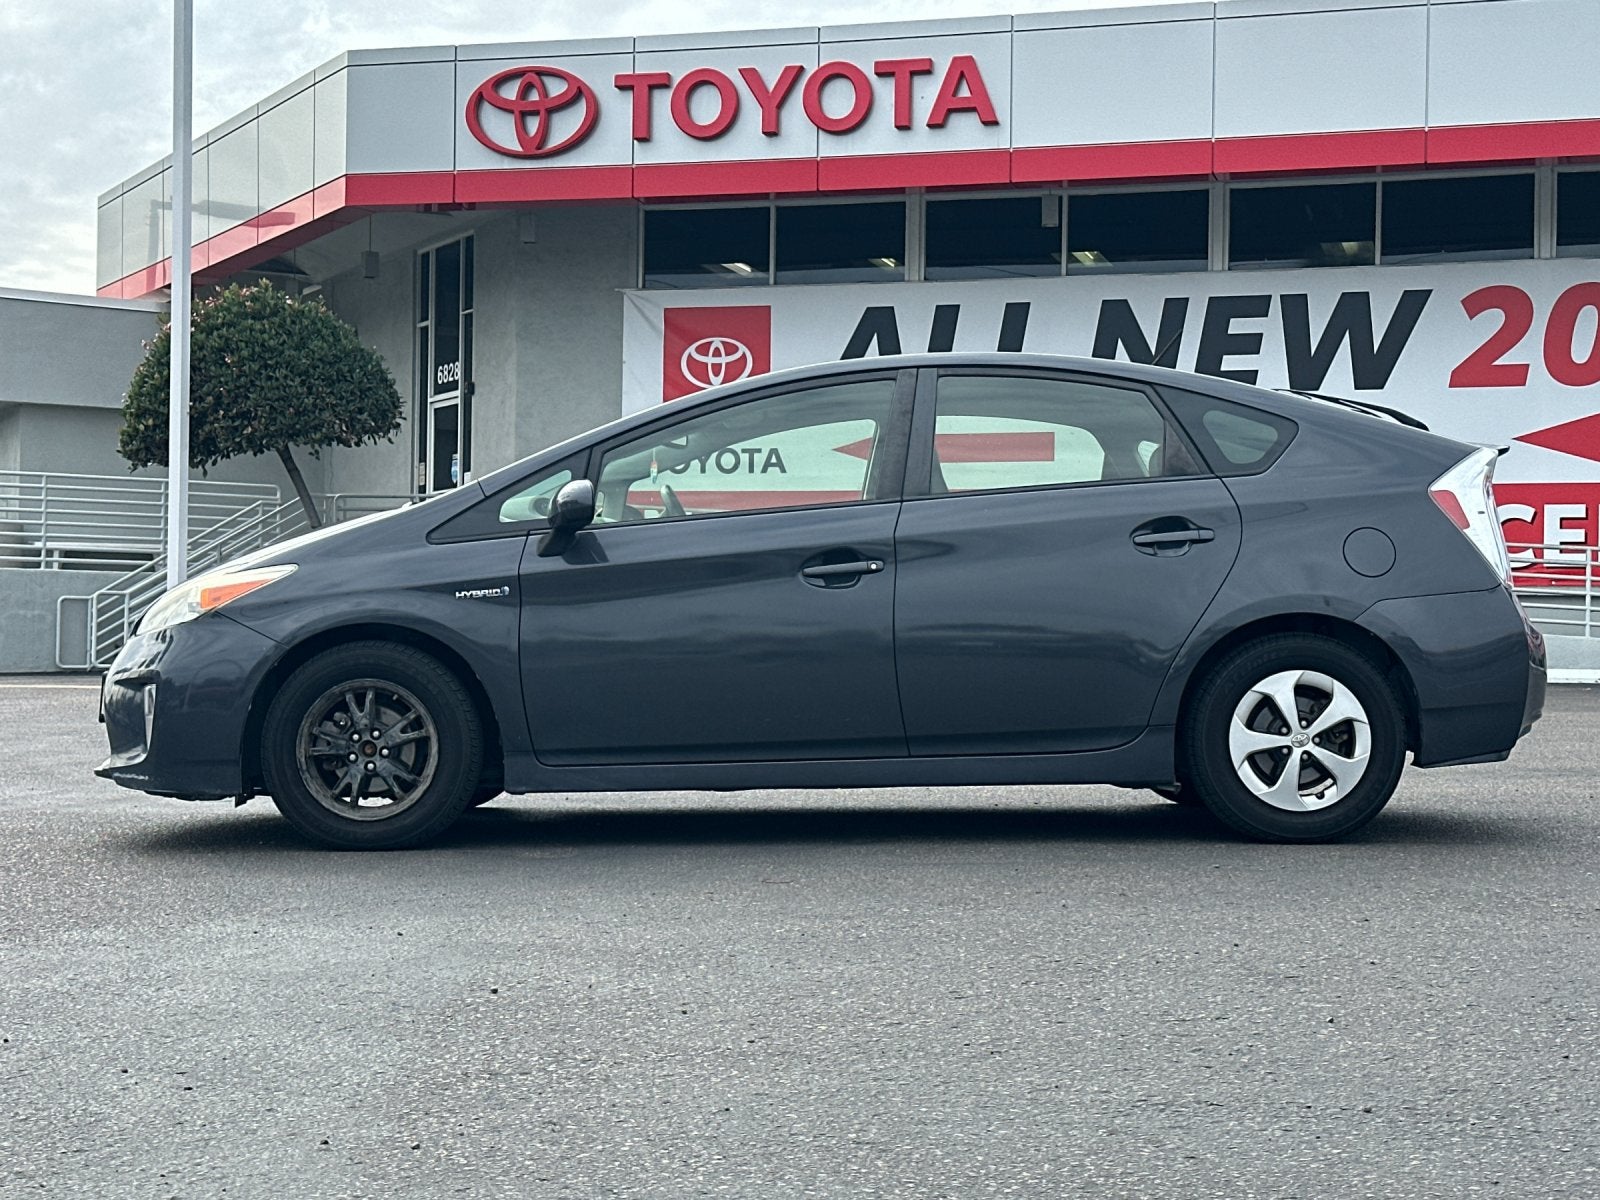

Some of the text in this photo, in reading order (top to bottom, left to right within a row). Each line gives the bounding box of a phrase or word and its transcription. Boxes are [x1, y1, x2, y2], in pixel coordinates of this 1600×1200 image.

[614, 54, 999, 142] TOYOTA
[1092, 289, 1433, 390] NEW
[437, 362, 459, 384] 6828
[1496, 503, 1600, 568] CE
[455, 588, 503, 600] HYBRID
